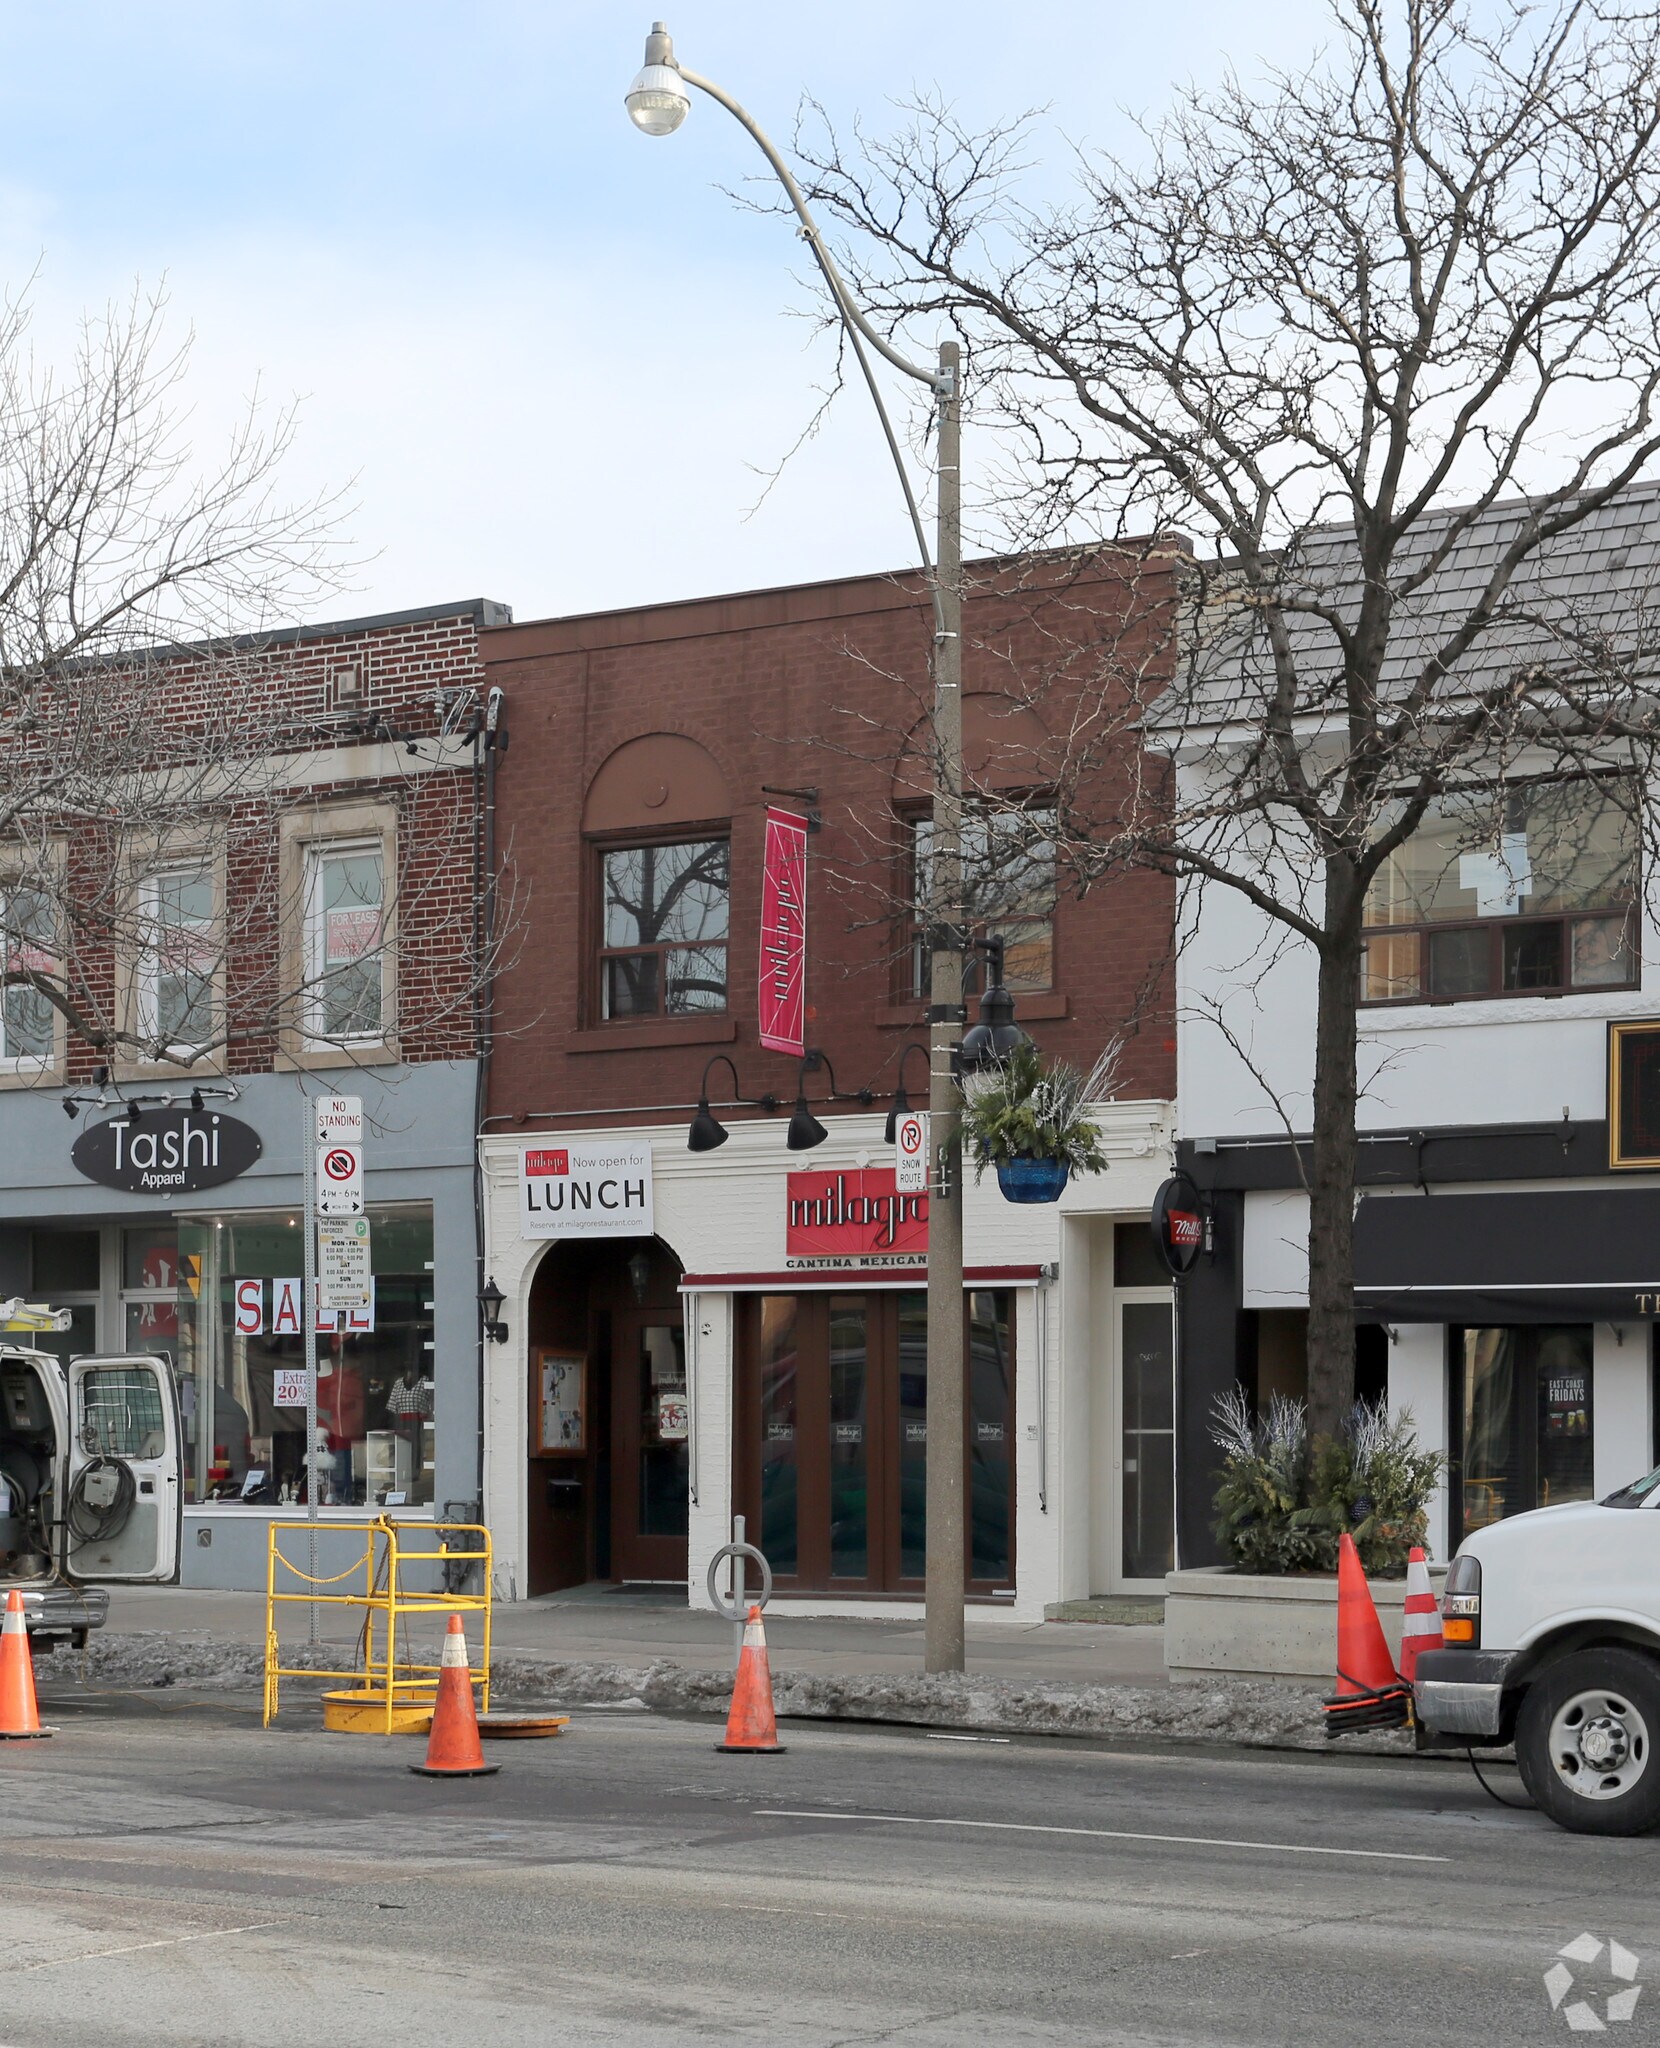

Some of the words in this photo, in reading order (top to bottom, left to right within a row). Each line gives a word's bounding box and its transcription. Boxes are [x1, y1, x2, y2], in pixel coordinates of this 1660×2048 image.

[331, 914, 348, 926] FOR
[350, 911, 378, 924] LEASE
[332, 1101, 346, 1112] NO
[319, 1115, 361, 1127] STANDING
[109, 1115, 219, 1169] Tashi
[527, 1152, 563, 1173] milagro
[573, 1157, 596, 1168] Now
[599, 1158, 626, 1169] open
[630, 1154, 644, 1165] for
[902, 1159, 921, 1169] SNOW
[141, 1171, 185, 1188] Apparel
[900, 1173, 922, 1183] ROUTE
[527, 1179, 645, 1211] LUNCH
[790, 1175, 929, 1248] milagro
[530, 1221, 556, 1229] Reserve
[557, 1221, 564, 1229] at
[565, 1219, 643, 1230] milagrorestaurant.com
[1174, 1219, 1197, 1235] Mill
[786, 1258, 852, 1268] CANTINA
[1549, 1379, 1564, 1389] EAST
[1565, 1379, 1585, 1389] COAST
[278, 1385, 307, 1399] 20%
[1549, 1388, 1585, 1401] FRIDAYS
